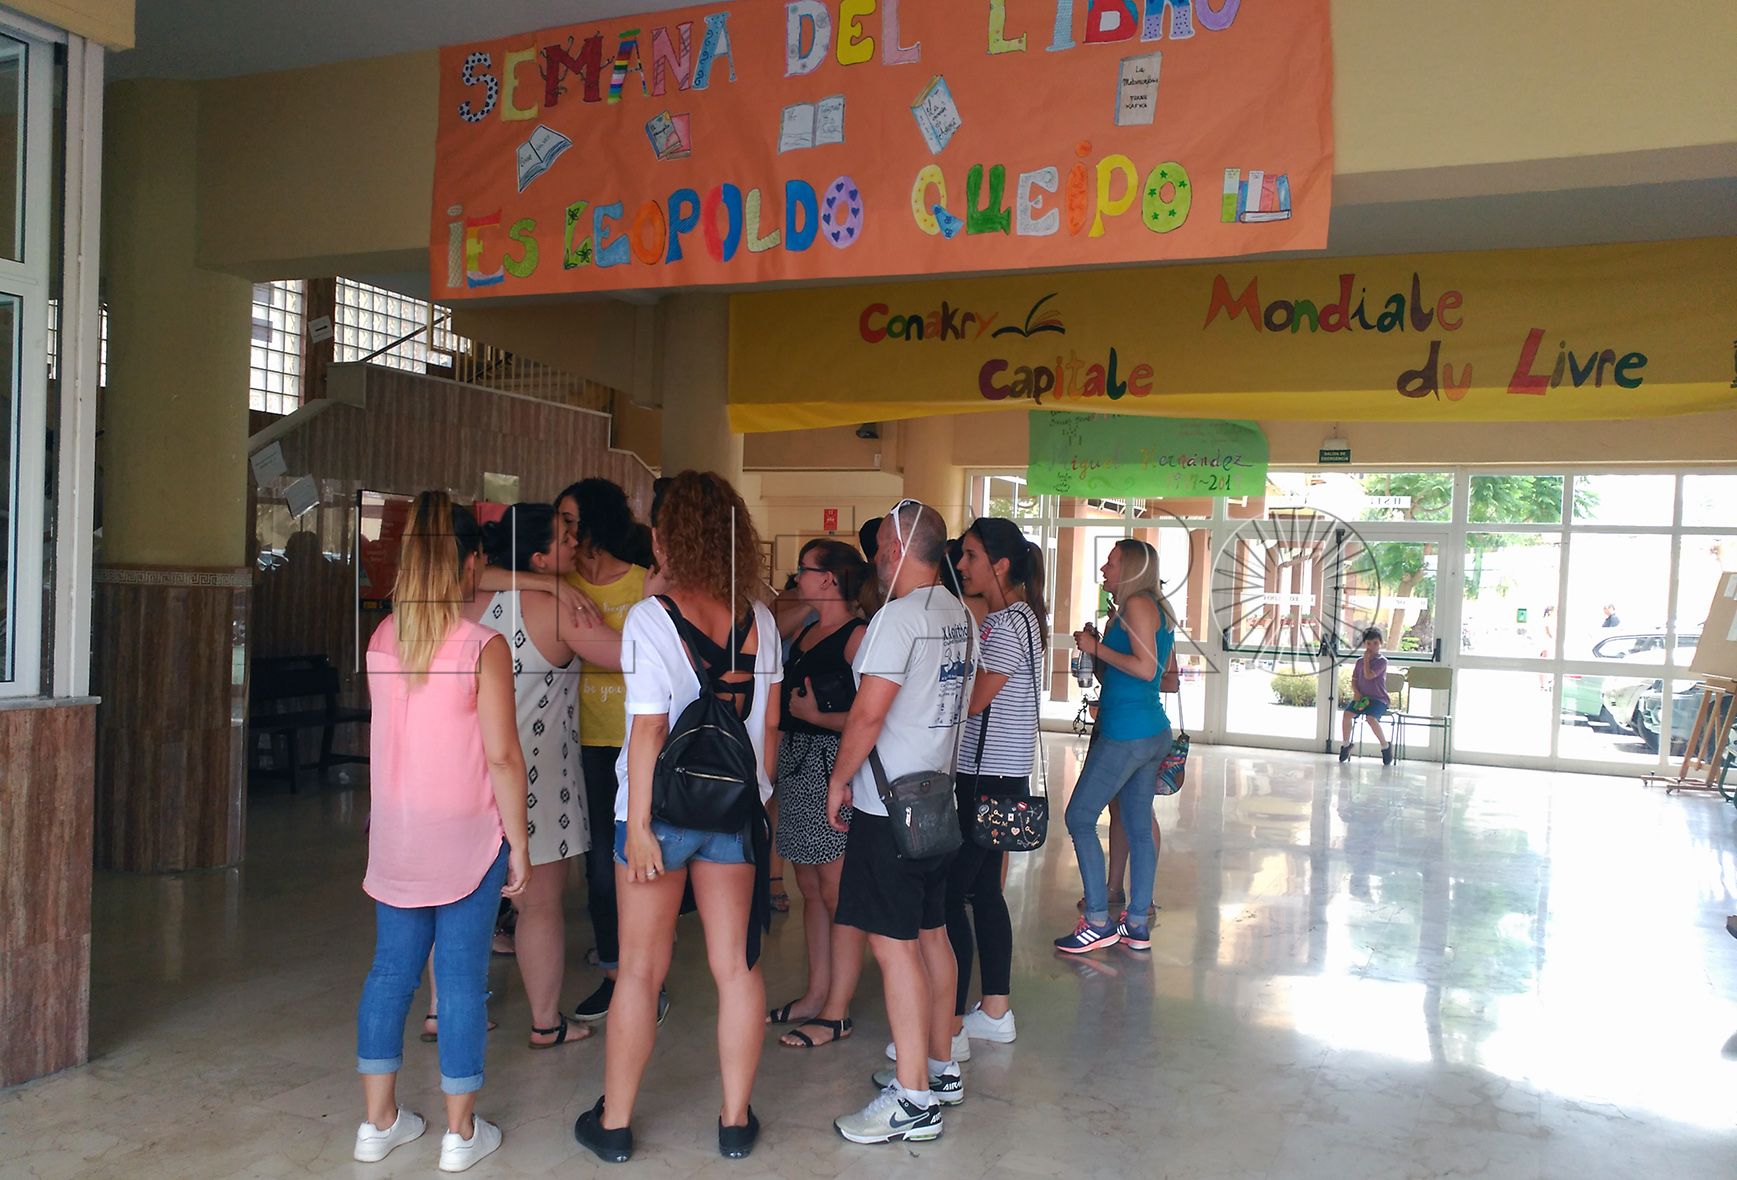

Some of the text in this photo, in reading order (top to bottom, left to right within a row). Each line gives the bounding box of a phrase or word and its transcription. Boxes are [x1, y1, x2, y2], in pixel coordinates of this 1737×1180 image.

[458, 11, 737, 123] SEMANA
[784, 0, 921, 78] DEL
[563, 175, 864, 270] LEOPOLDO
[859, 301, 998, 343] Conakry
[1202, 272, 1464, 333] Mondiale
[978, 347, 1154, 405] Capitale
[1396, 327, 1648, 401] du Livre
